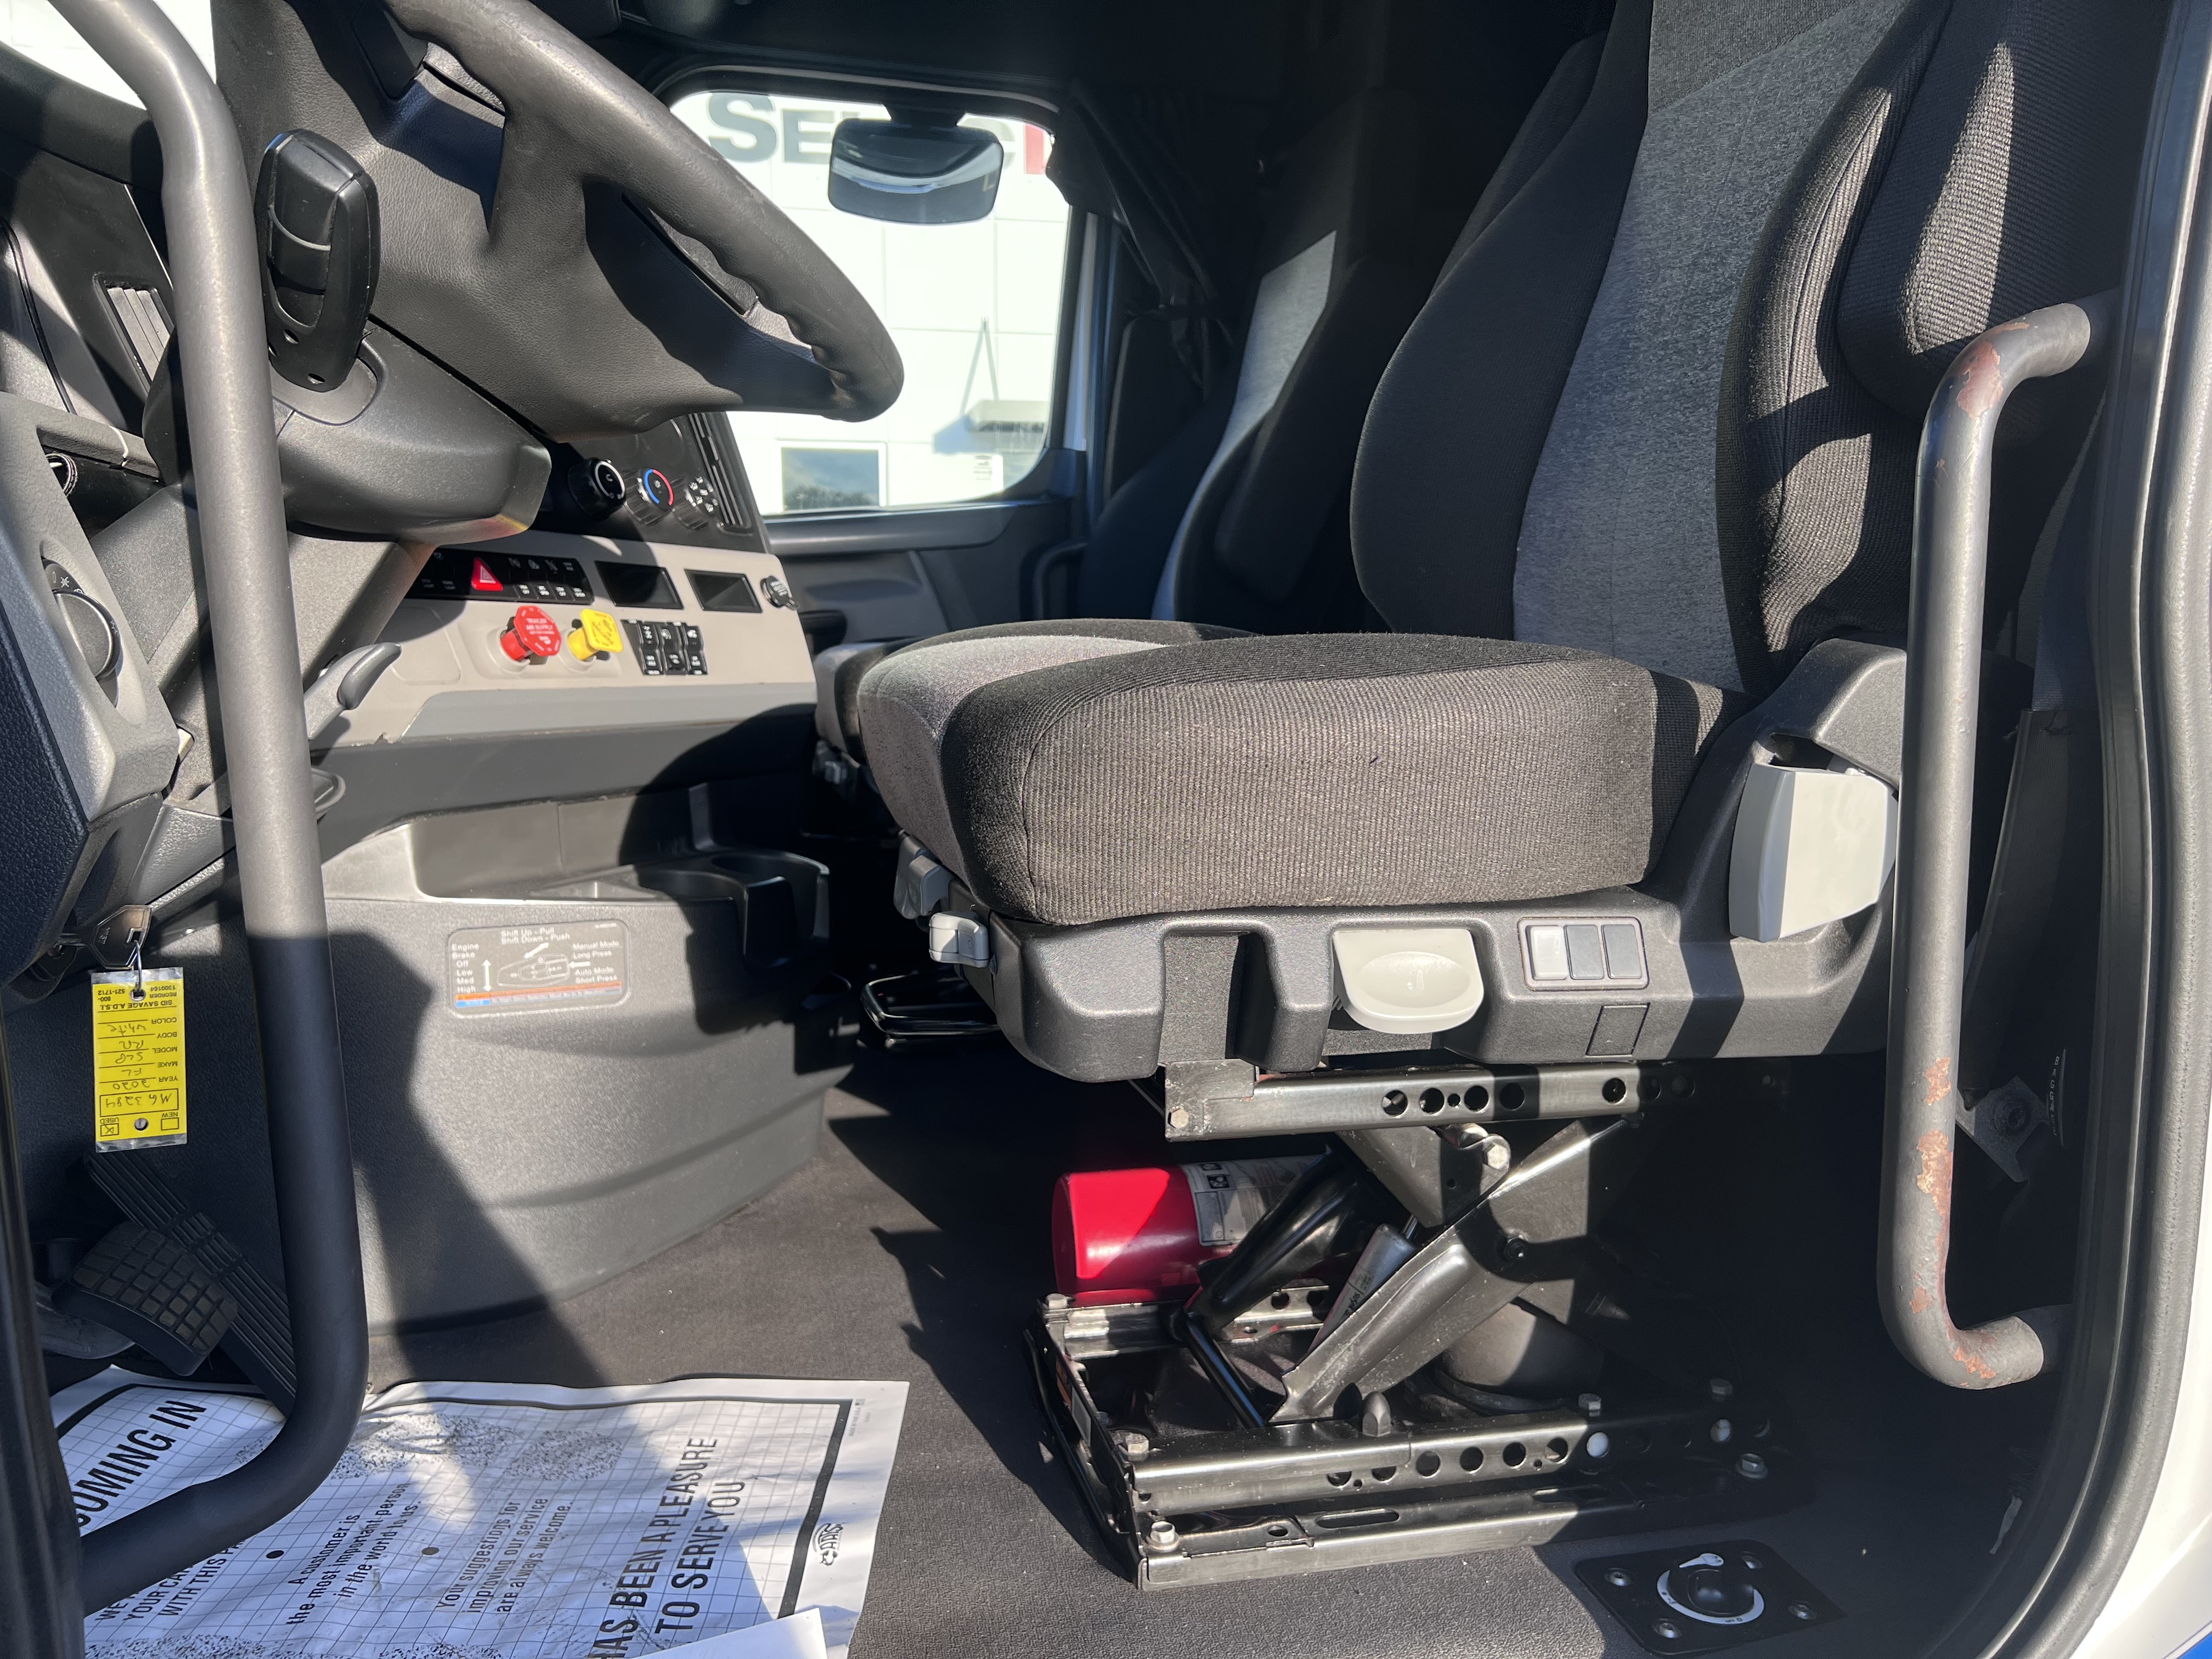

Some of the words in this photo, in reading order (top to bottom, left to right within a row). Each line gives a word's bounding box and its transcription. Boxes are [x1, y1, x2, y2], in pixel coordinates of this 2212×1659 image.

[452, 943, 479, 952] Engine
[452, 951, 475, 960] Brake
[501, 936, 518, 945] Shift
[551, 933, 570, 941] Push
[573, 942, 599, 950] Manual
[573, 951, 590, 960] Long
[456, 960, 469, 968] Off
[112, 1079, 150, 1090] 2020
[149, 1400, 207, 1430] IN
[648, 1437, 718, 1528] PLEASURE
[701, 1481, 746, 1521] YOU
[285, 1602, 315, 1624] the
[307, 1570, 341, 1599] most
[328, 1520, 383, 1567] important
[375, 1483, 410, 1516] person
[301, 1527, 351, 1575] customer
[338, 1514, 360, 1525] is
[333, 1586, 357, 1598] in
[345, 1564, 373, 1583] the
[364, 1531, 398, 1561] world
[386, 1520, 407, 1529] to
[400, 1501, 422, 1517] us.
[436, 1584, 467, 1609] Your
[459, 1518, 511, 1581] suggestions
[499, 1502, 521, 1516] for
[461, 1559, 516, 1613] improving
[504, 1538, 525, 1556] our
[516, 1498, 549, 1536] service
[641, 1531, 677, 1543] A
[496, 1592, 519, 1613] are
[510, 1552, 544, 1588] always
[534, 1502, 574, 1549] welcome.
[670, 1525, 730, 1590] SERVE
[158, 1587, 201, 1616] WITH
[189, 1558, 227, 1584] THIS
[609, 1549, 668, 1608] BEEN
[122, 1590, 170, 1621] YOUR
[654, 1600, 701, 1634] TO
